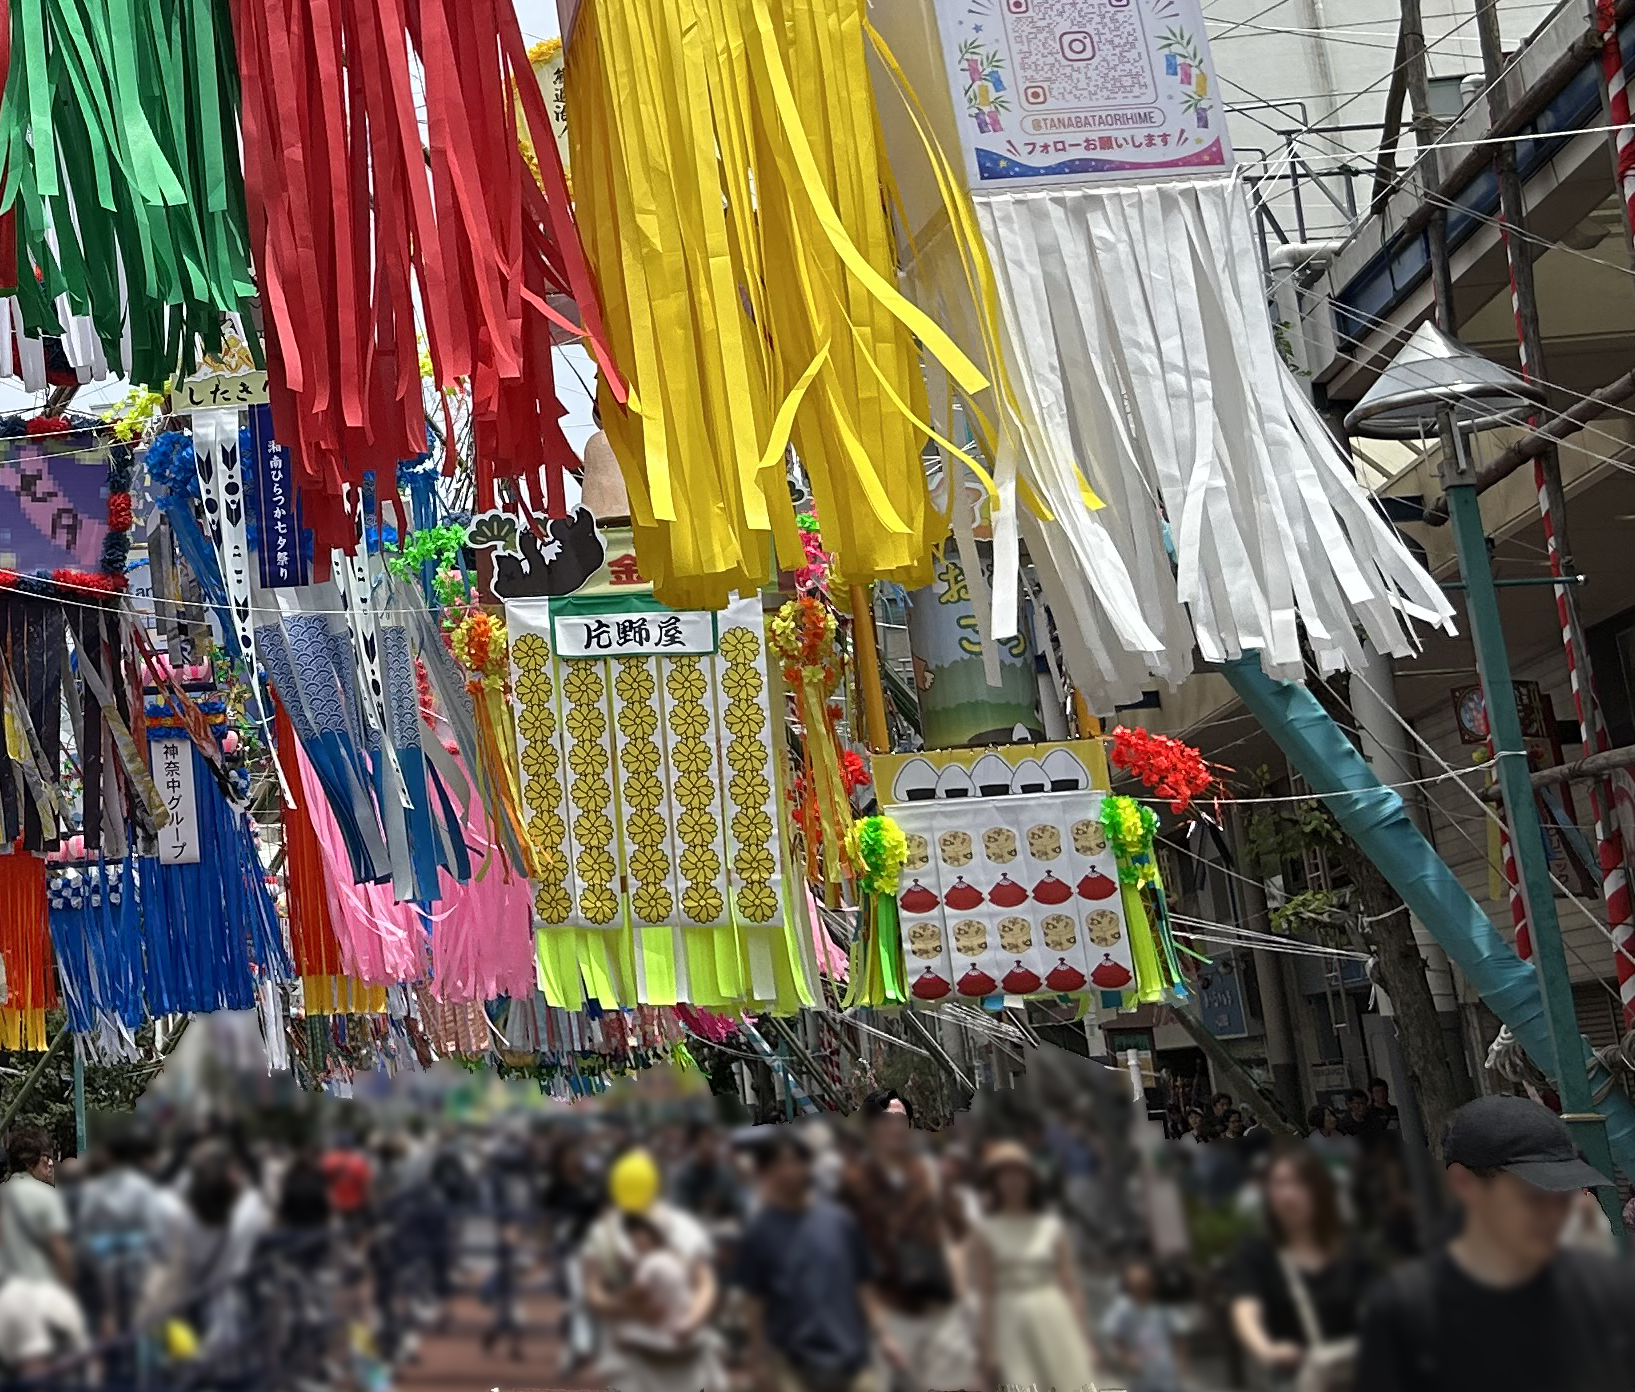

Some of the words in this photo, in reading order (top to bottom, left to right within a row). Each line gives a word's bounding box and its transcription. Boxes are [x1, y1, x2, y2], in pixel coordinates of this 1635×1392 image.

[1023, 132, 1172, 156] フォローお願いします
[188, 377, 269, 406] したき
[582, 616, 688, 651] 片野屋
[163, 743, 188, 860] 神奈中グループ
